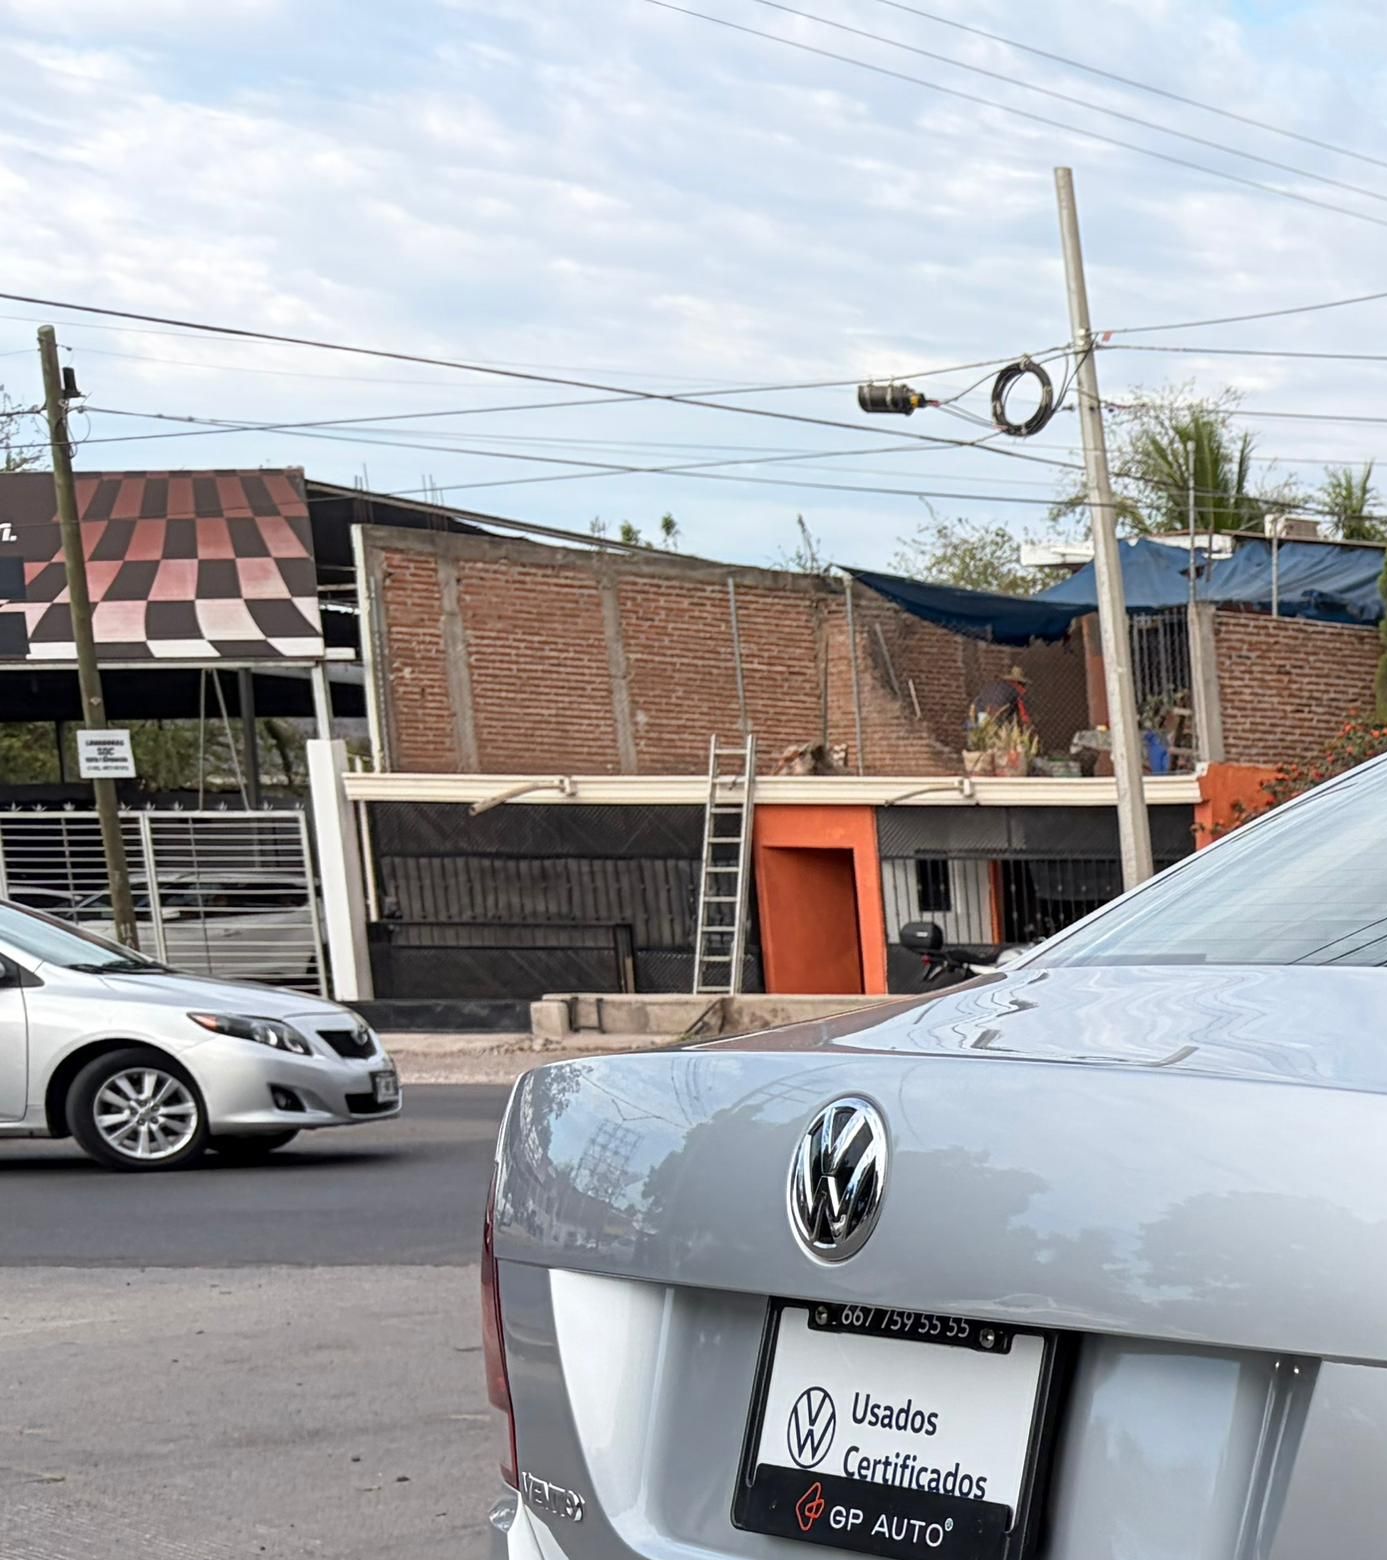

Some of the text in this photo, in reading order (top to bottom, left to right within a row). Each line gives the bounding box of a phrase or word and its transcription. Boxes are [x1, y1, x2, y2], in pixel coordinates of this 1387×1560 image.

[852, 1391, 939, 1437] Usados
[843, 1445, 988, 1500] Certificados
[829, 1505, 864, 1531] GP
